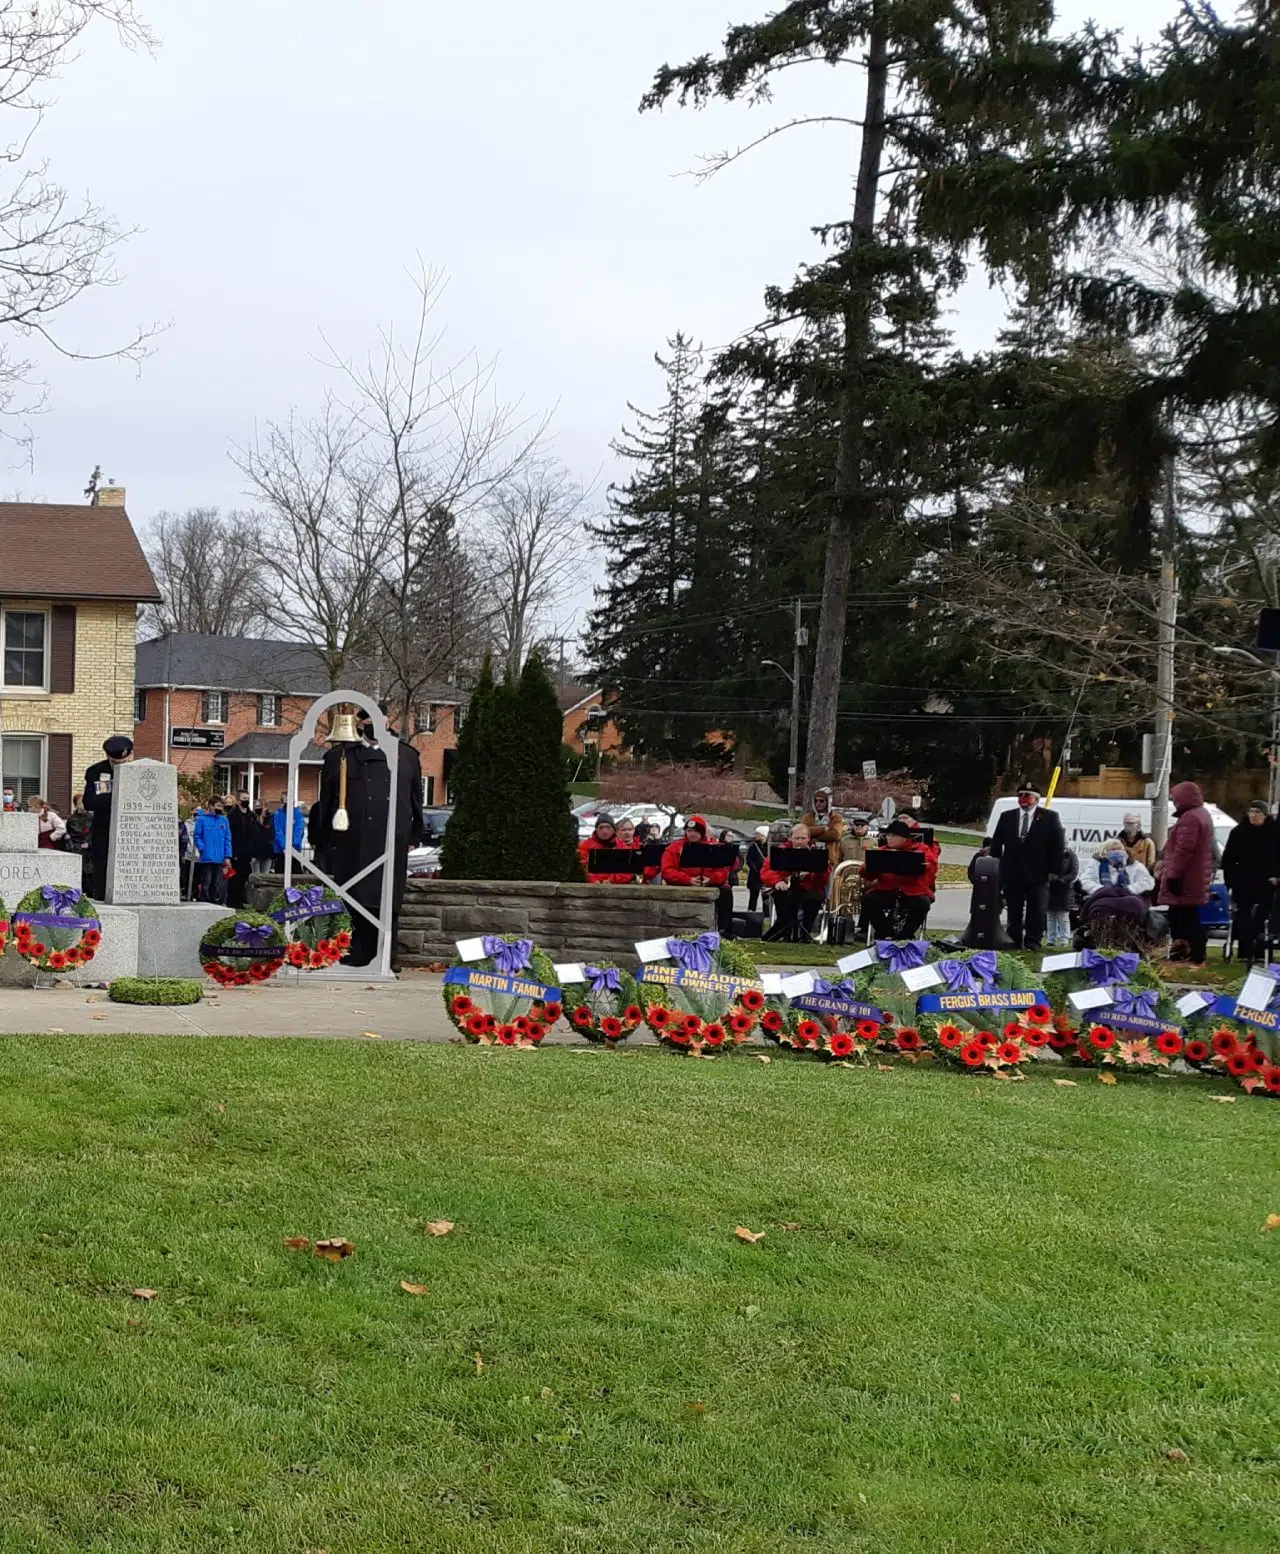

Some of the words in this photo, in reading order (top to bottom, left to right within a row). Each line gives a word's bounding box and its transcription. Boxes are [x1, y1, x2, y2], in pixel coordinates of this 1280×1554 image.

[864, 767, 875, 776] 50
[468, 971, 510, 993] MARTIN
[510, 979, 548, 999] FAMILY
[642, 973, 677, 986] HOME
[680, 977, 731, 993] OWNERS
[643, 964, 681, 977] PINE
[684, 969, 765, 990] MEADOWS
[800, 996, 817, 1006] THE
[817, 998, 849, 1012] GRAND
[939, 994, 978, 1010] FERGUS
[978, 992, 1010, 1009] BRASS
[1010, 991, 1037, 1007] BAND
[1110, 1013, 1127, 1022] RED
[1127, 1016, 1160, 1029] ARROWS
